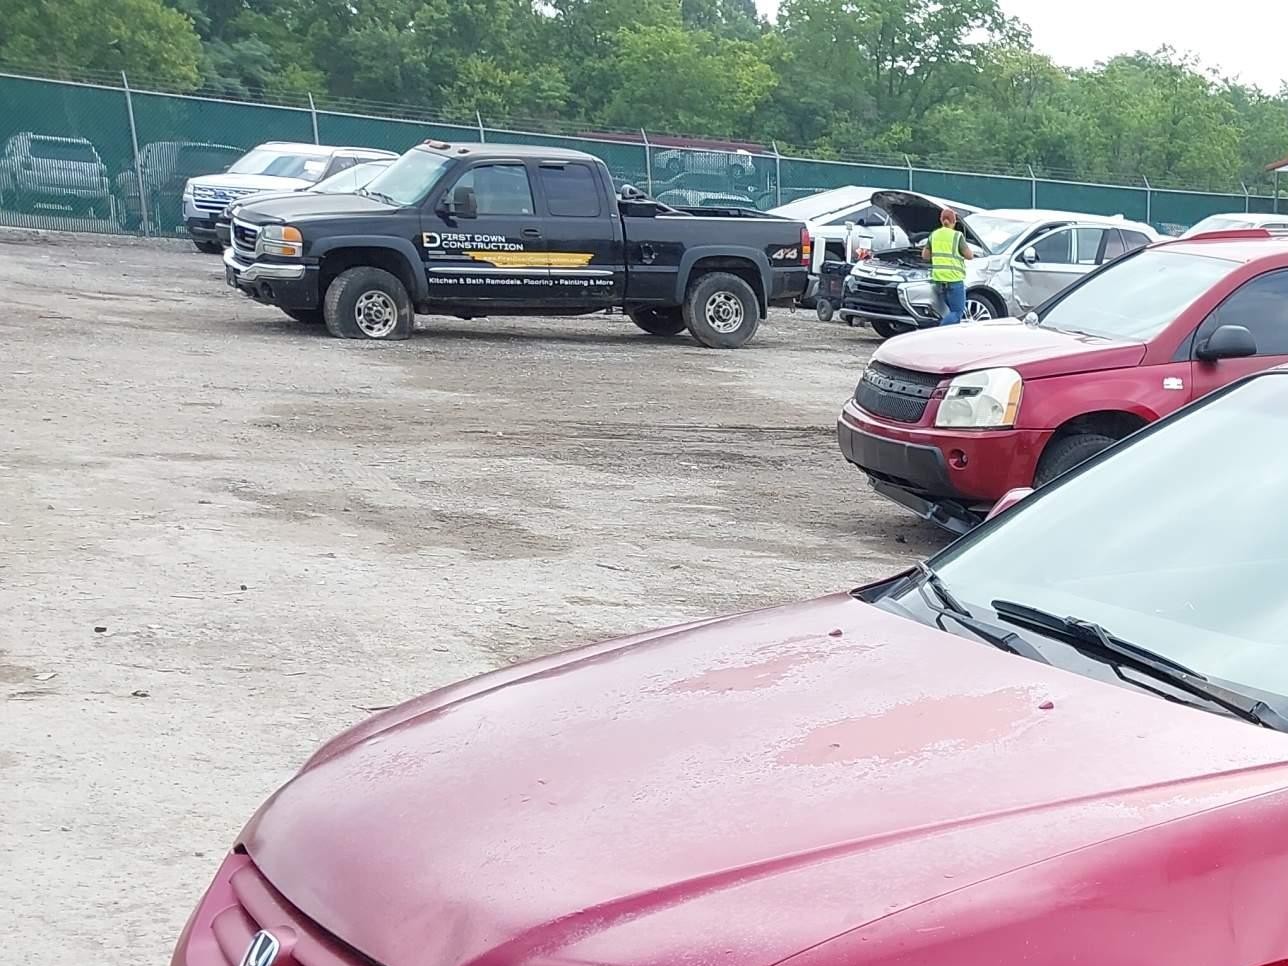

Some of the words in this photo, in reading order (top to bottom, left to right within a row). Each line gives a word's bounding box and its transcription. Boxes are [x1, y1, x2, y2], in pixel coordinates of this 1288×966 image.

[441, 233, 472, 241] FIRST
[474, 234, 506, 242] DOWN
[441, 241, 524, 251] CONSTRUCTION
[523, 278, 553, 286] Flooring
[559, 279, 588, 287] Painting
